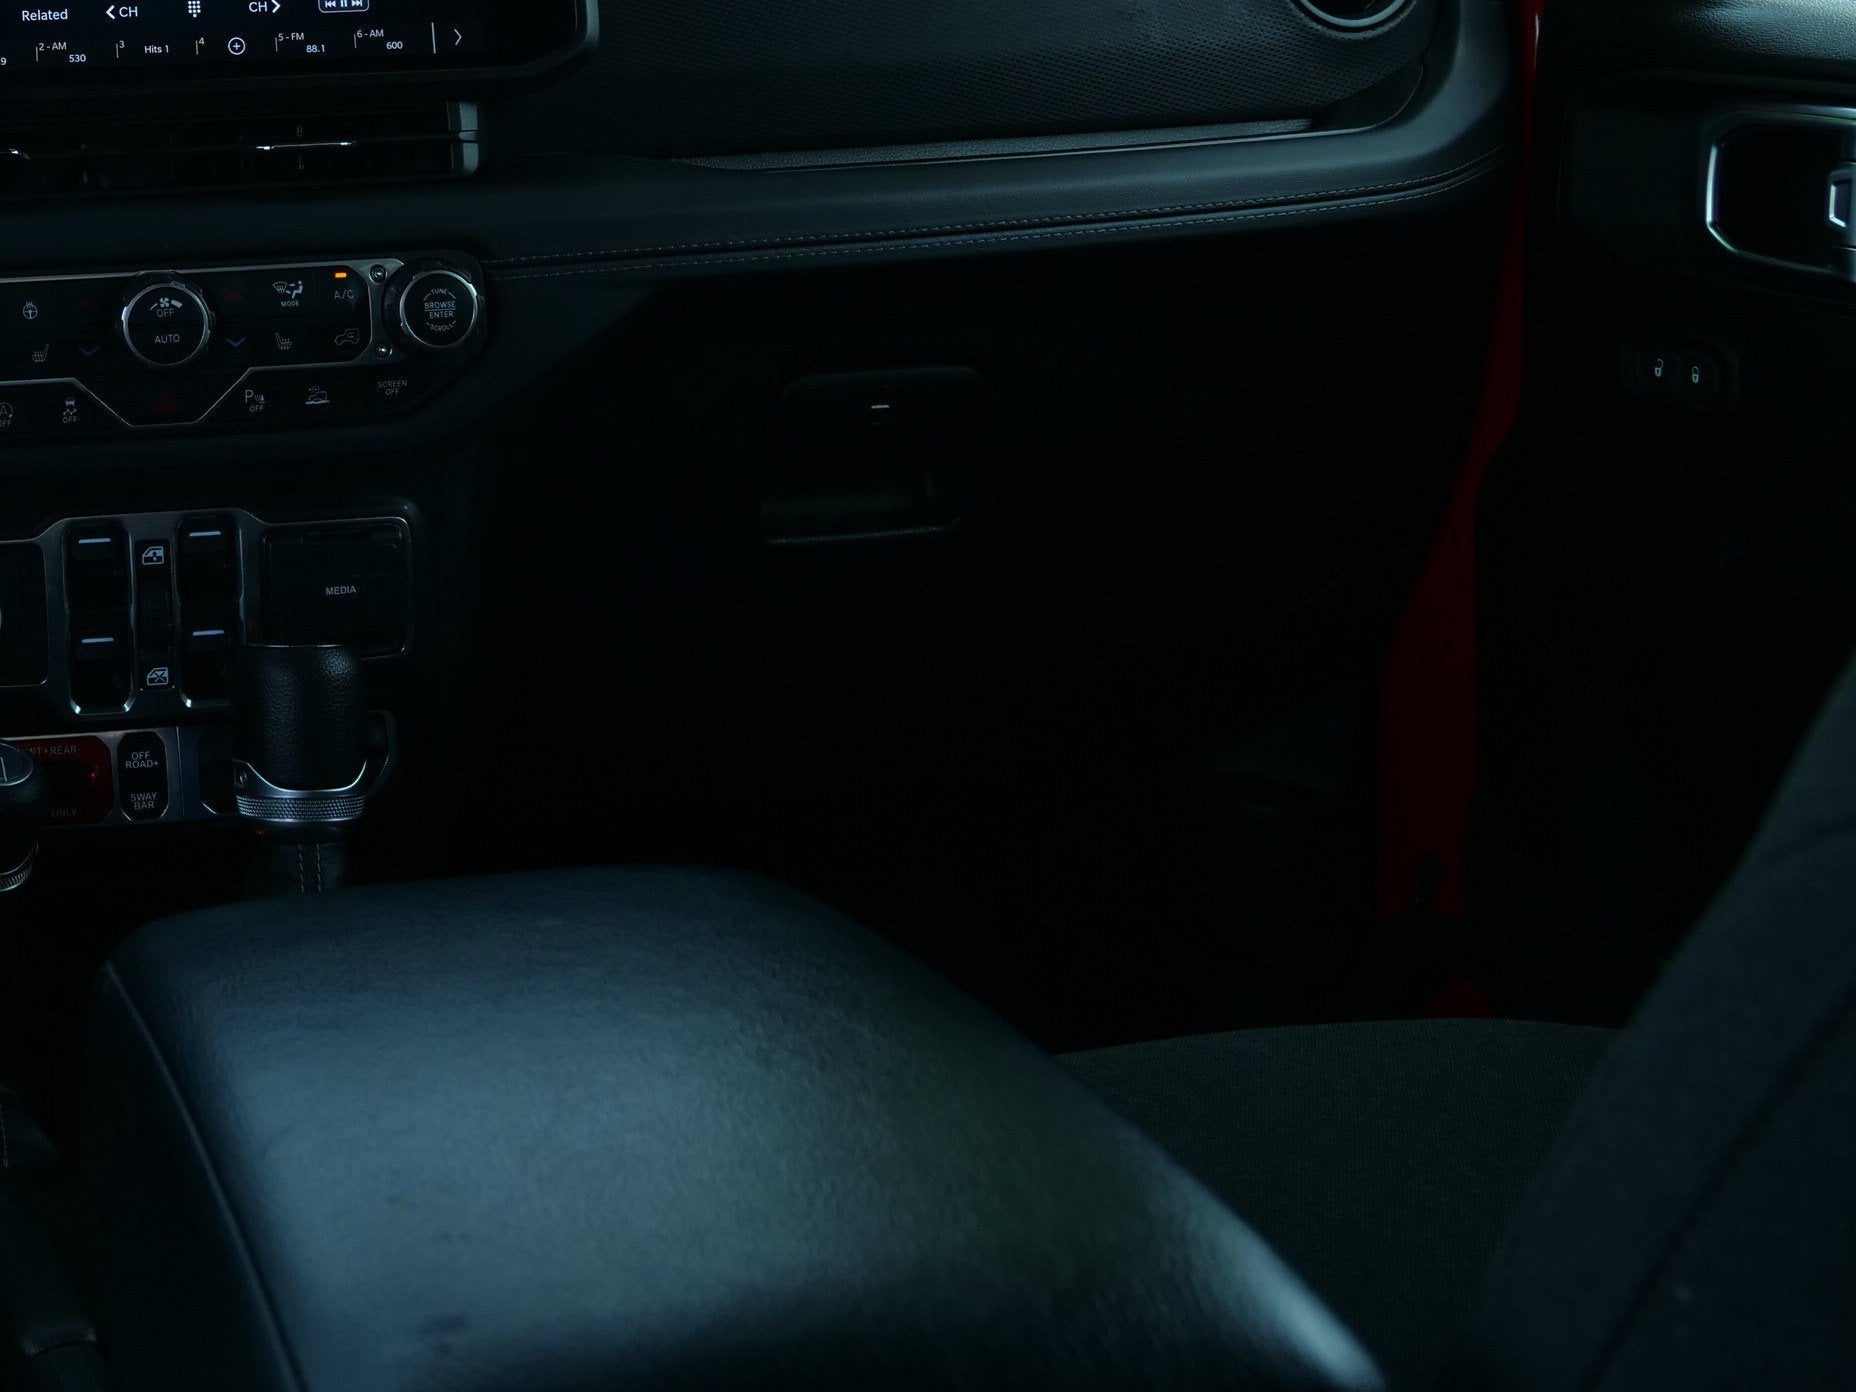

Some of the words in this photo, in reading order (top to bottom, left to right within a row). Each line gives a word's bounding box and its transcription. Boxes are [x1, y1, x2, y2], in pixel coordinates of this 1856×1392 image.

[118, 6, 139, 18] CH
[248, 1, 268, 13] CH
[21, 8, 69, 22] Related
[291, 32, 305, 41] FM
[369, 28, 385, 38] AM
[51, 41, 67, 51] AM
[118, 40, 126, 49] 3
[199, 36, 205, 46] 4
[386, 40, 404, 50] 600
[144, 45, 163, 54] Hits
[306, 44, 326, 53] 88.1
[69, 53, 87, 63] 530
[333, 289, 355, 300] A/C
[431, 287, 448, 295] TUNE
[280, 299, 300, 308] MODE
[424, 300, 457, 310] BROWSE
[156, 308, 175, 319] OFF
[429, 310, 454, 320] ENTER
[429, 322, 455, 333] SCROLL
[154, 333, 180, 345] AUTO
[377, 379, 408, 390] SCREEN
[385, 388, 400, 396] OFF
[249, 403, 265, 413] OFF
[62, 415, 78, 425] OFF
[325, 585, 357, 596] MEDIA
[131, 750, 150, 760] OFF
[125, 760, 159, 770] ROAD+
[130, 792, 159, 802] SWAY
[134, 801, 155, 811] BAR
[51, 807, 78, 819] ONLY
